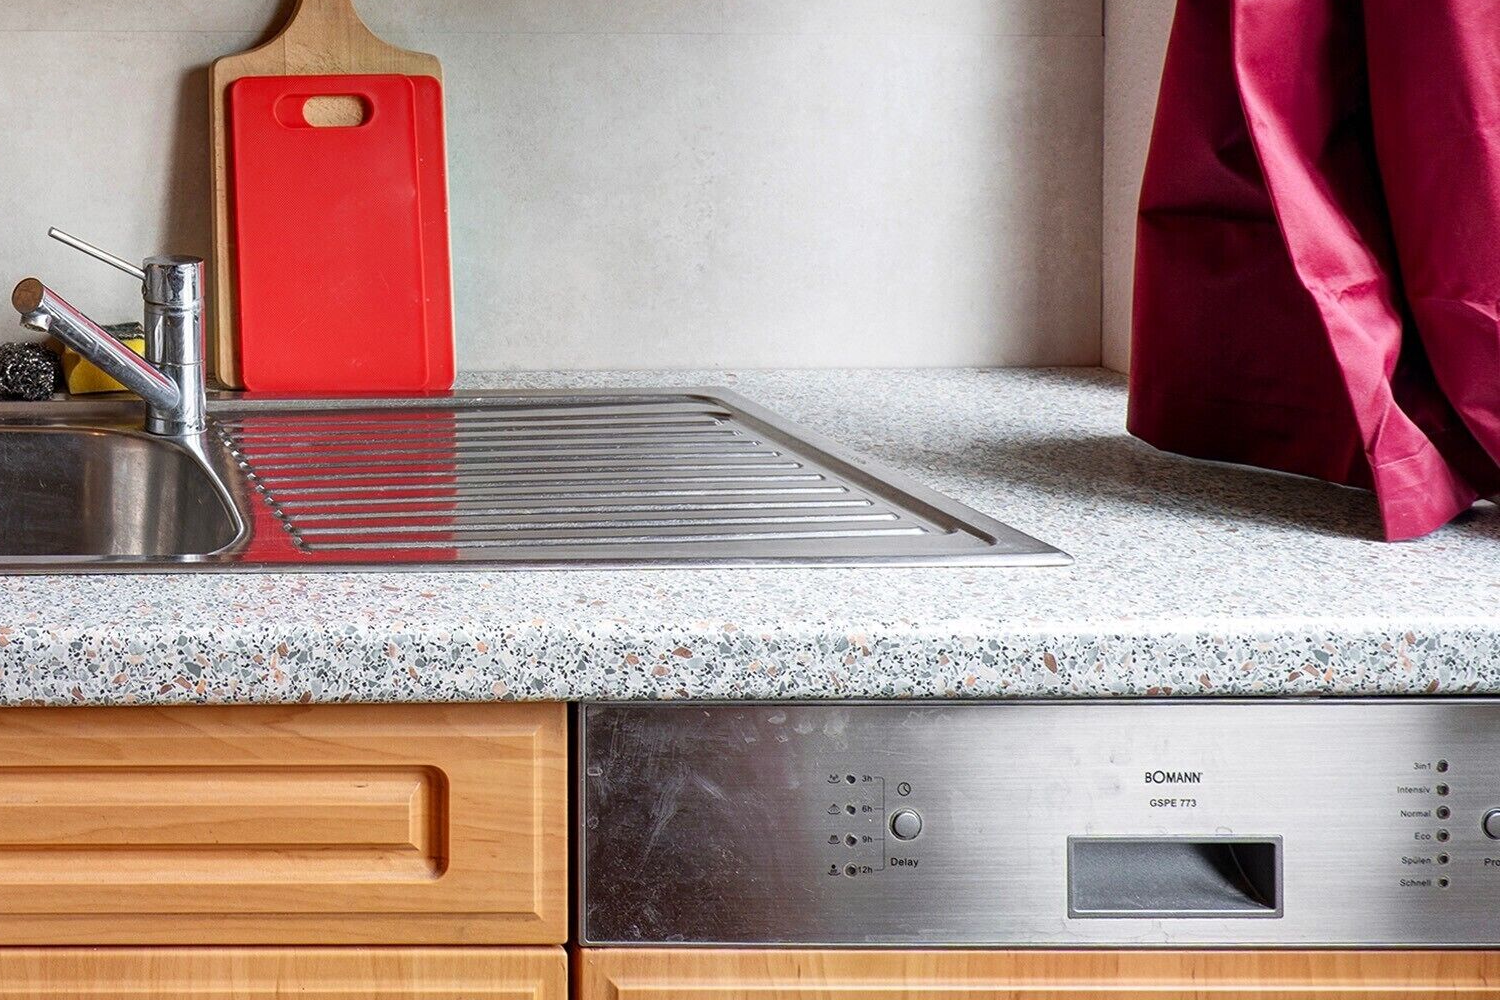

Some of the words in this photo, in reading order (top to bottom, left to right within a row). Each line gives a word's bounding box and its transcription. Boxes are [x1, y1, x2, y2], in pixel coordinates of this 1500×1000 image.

[1413, 762, 1432, 770] 3in1
[861, 774, 873, 782] 3h
[1144, 770, 1201, 784] BOMANN
[1397, 785, 1431, 794] Intensiv
[1149, 798, 1177, 807] GSPE
[1180, 798, 1197, 807] 773
[861, 805, 873, 813] 6h
[1400, 809, 1432, 818] Normal
[861, 835, 873, 843] 9h
[1414, 832, 1432, 840] Eco
[890, 857, 919, 868] Delay
[1401, 855, 1432, 866] Spülen
[858, 865, 873, 873] 12h
[1399, 879, 1432, 887] Schnell
